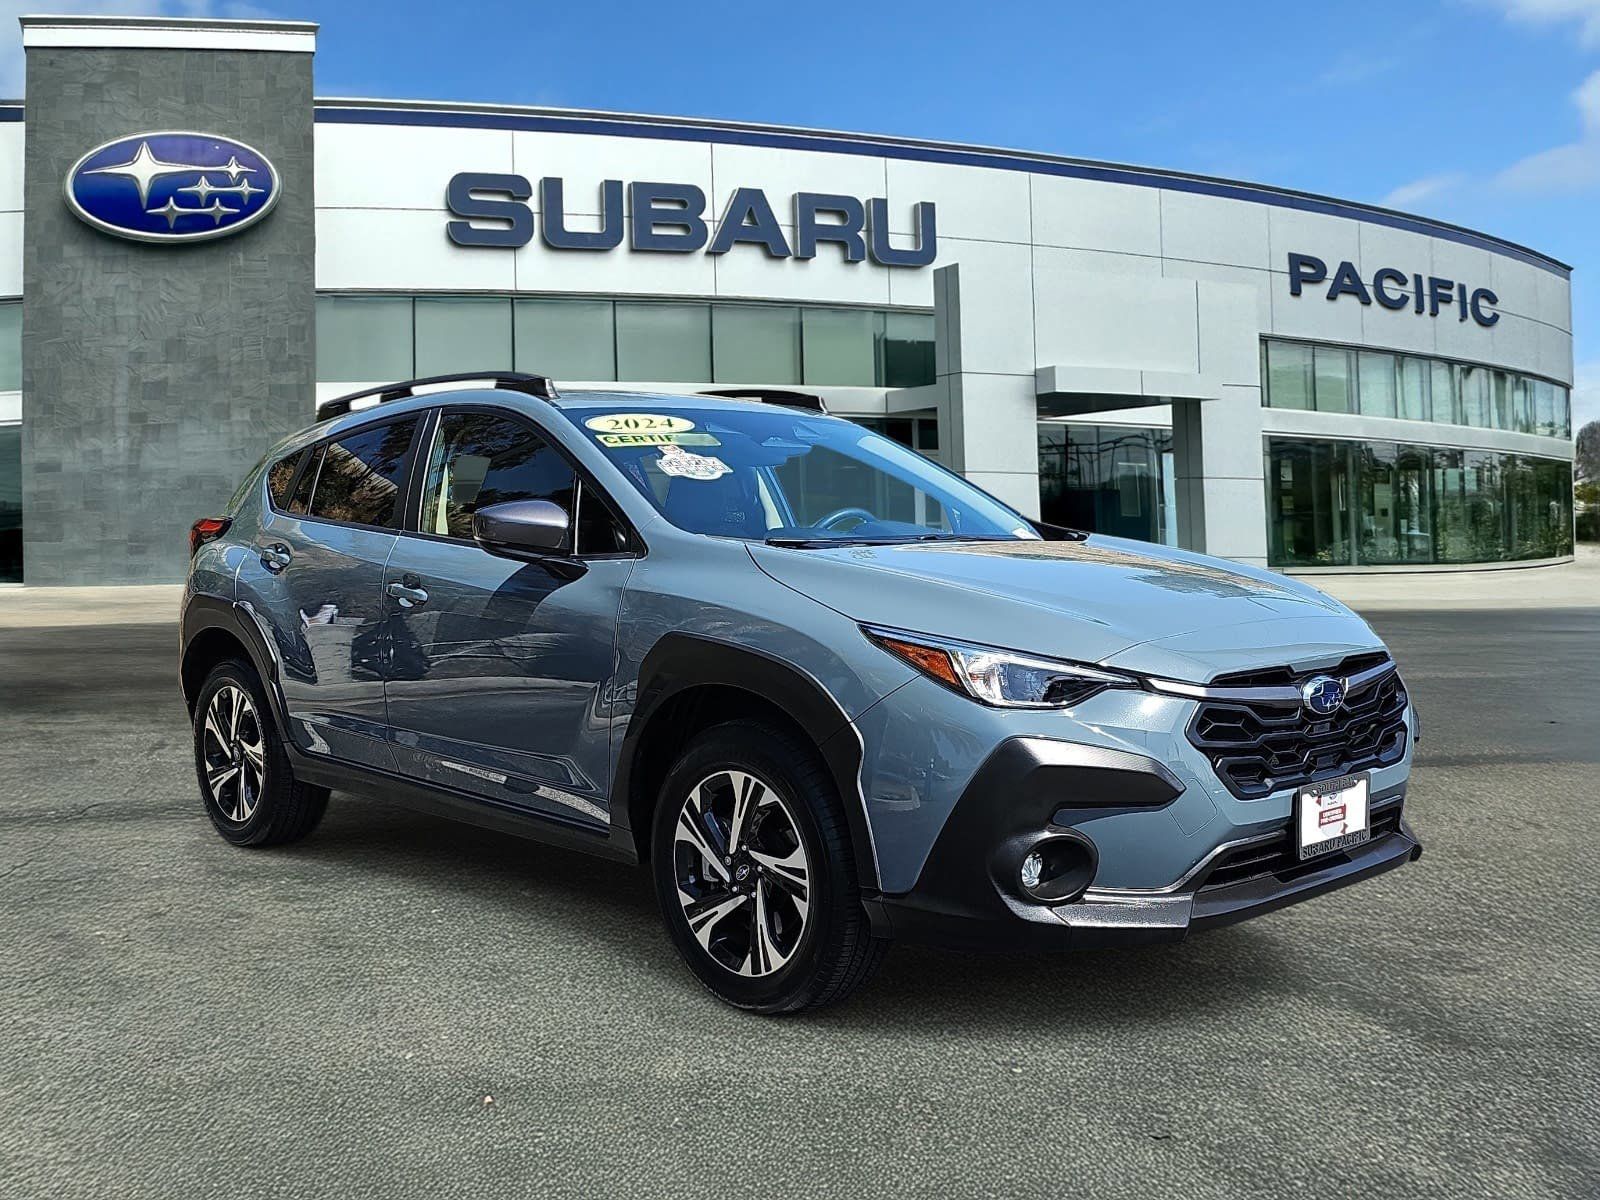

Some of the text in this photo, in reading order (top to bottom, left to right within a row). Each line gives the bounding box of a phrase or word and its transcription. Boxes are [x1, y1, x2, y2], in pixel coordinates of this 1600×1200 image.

[447, 172, 936, 267] SUBARU
[1288, 252, 1499, 327] PACIFIC
[606, 418, 675, 430] 2024
[603, 434, 673, 444] CERTIF
[1303, 831, 1367, 858] SUBARU PACIFIC
